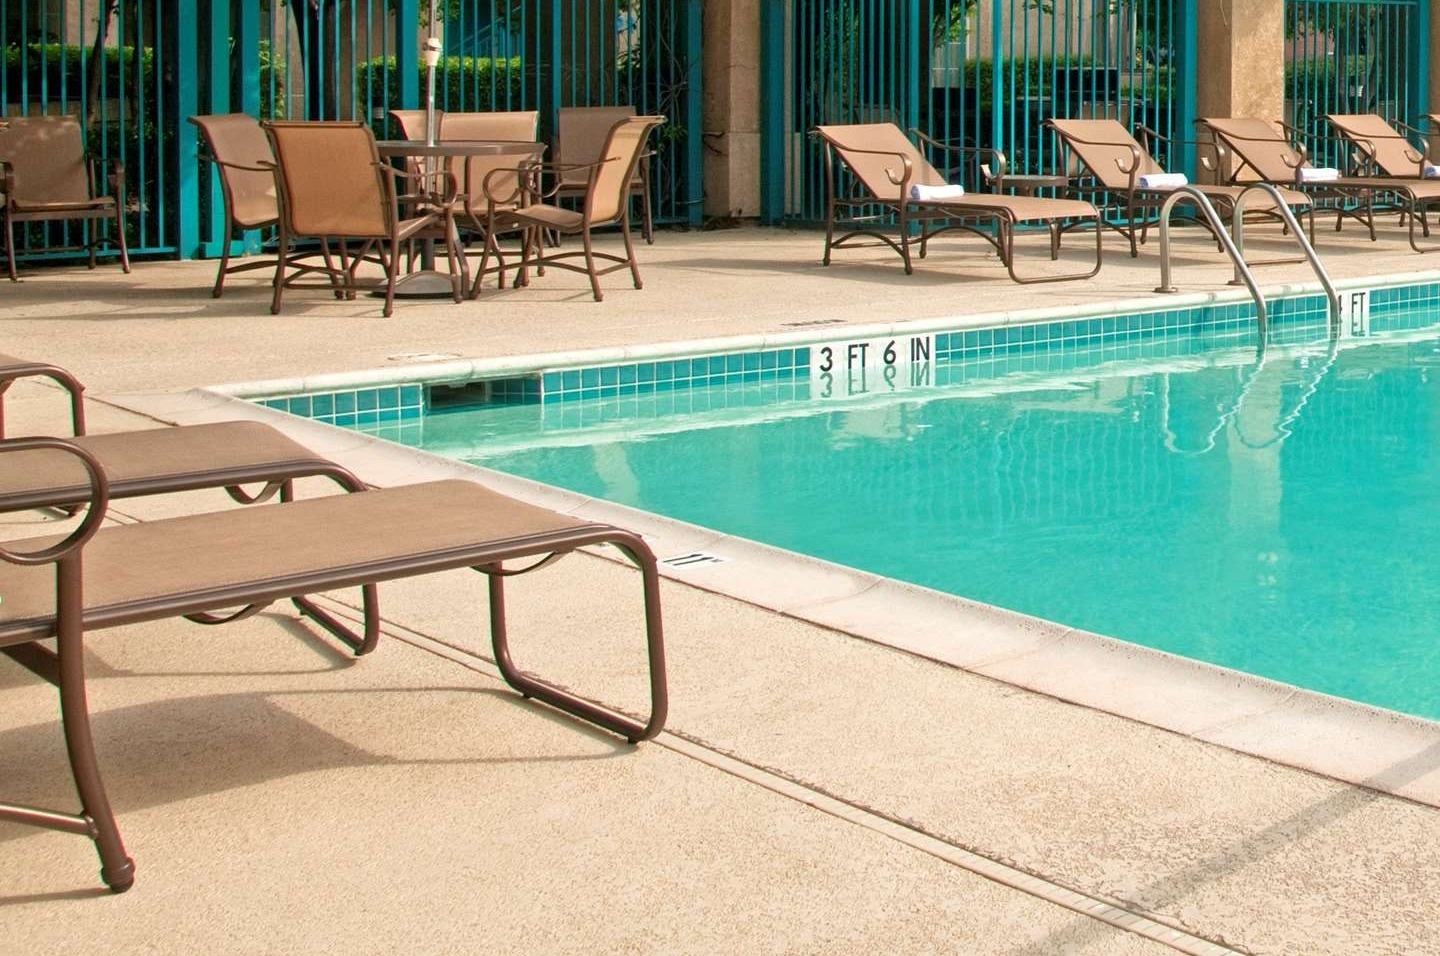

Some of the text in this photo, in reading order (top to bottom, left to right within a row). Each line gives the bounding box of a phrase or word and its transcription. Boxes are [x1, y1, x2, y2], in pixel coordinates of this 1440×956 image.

[1352, 292, 1366, 314] FT
[820, 336, 930, 372] 3 FT 6 IN
